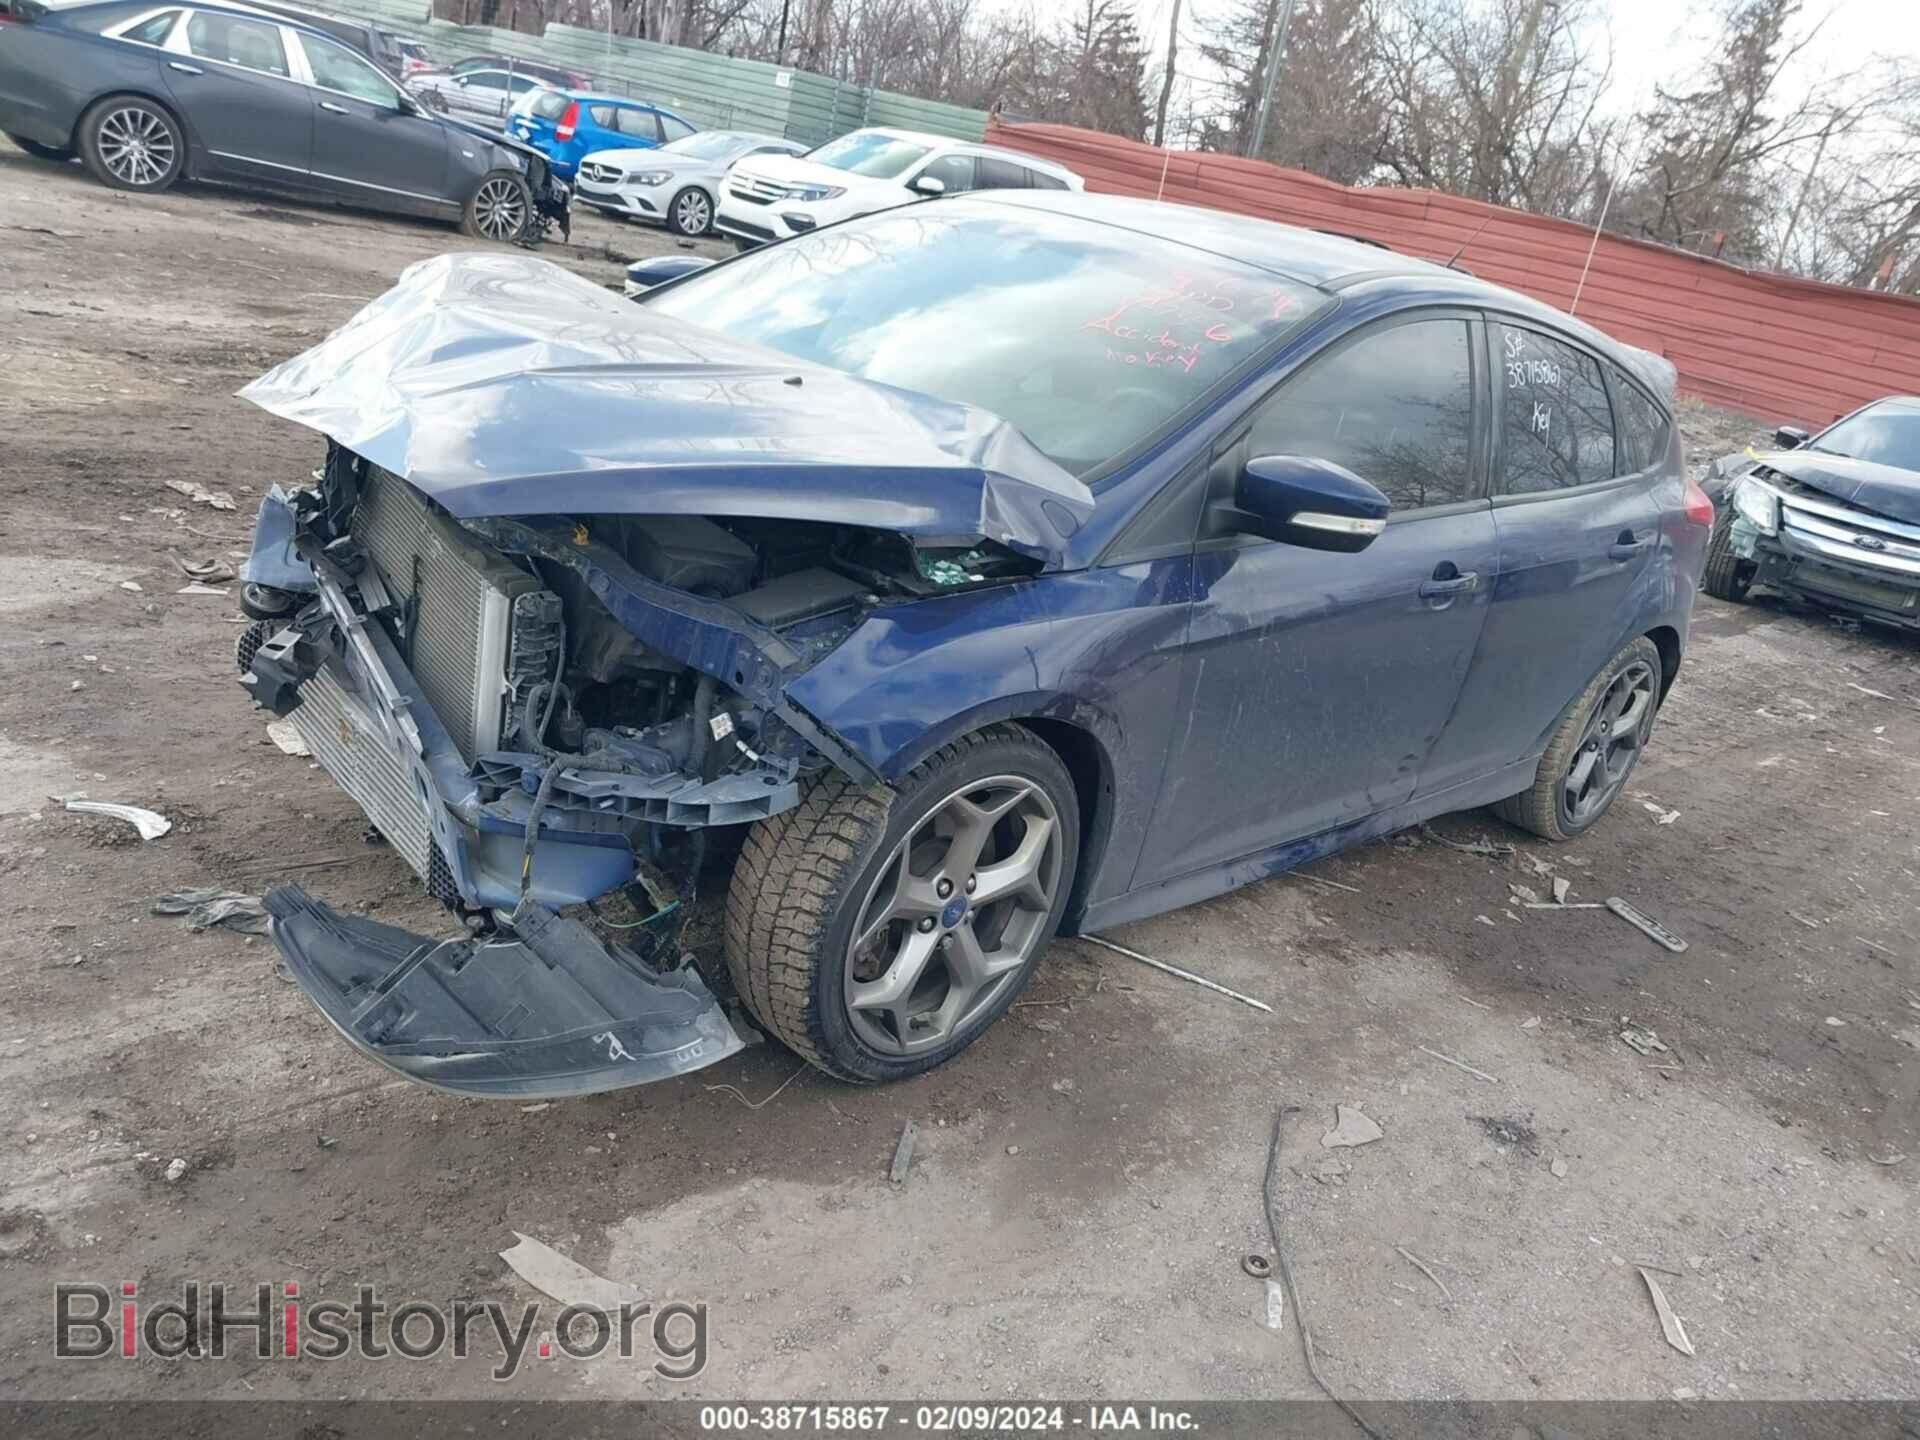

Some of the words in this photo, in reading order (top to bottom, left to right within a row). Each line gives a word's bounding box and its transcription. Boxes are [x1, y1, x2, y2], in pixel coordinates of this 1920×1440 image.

[1504, 331, 1526, 358] S#
[1505, 359, 1561, 389] 38715867
[1531, 400, 1552, 449] Key
